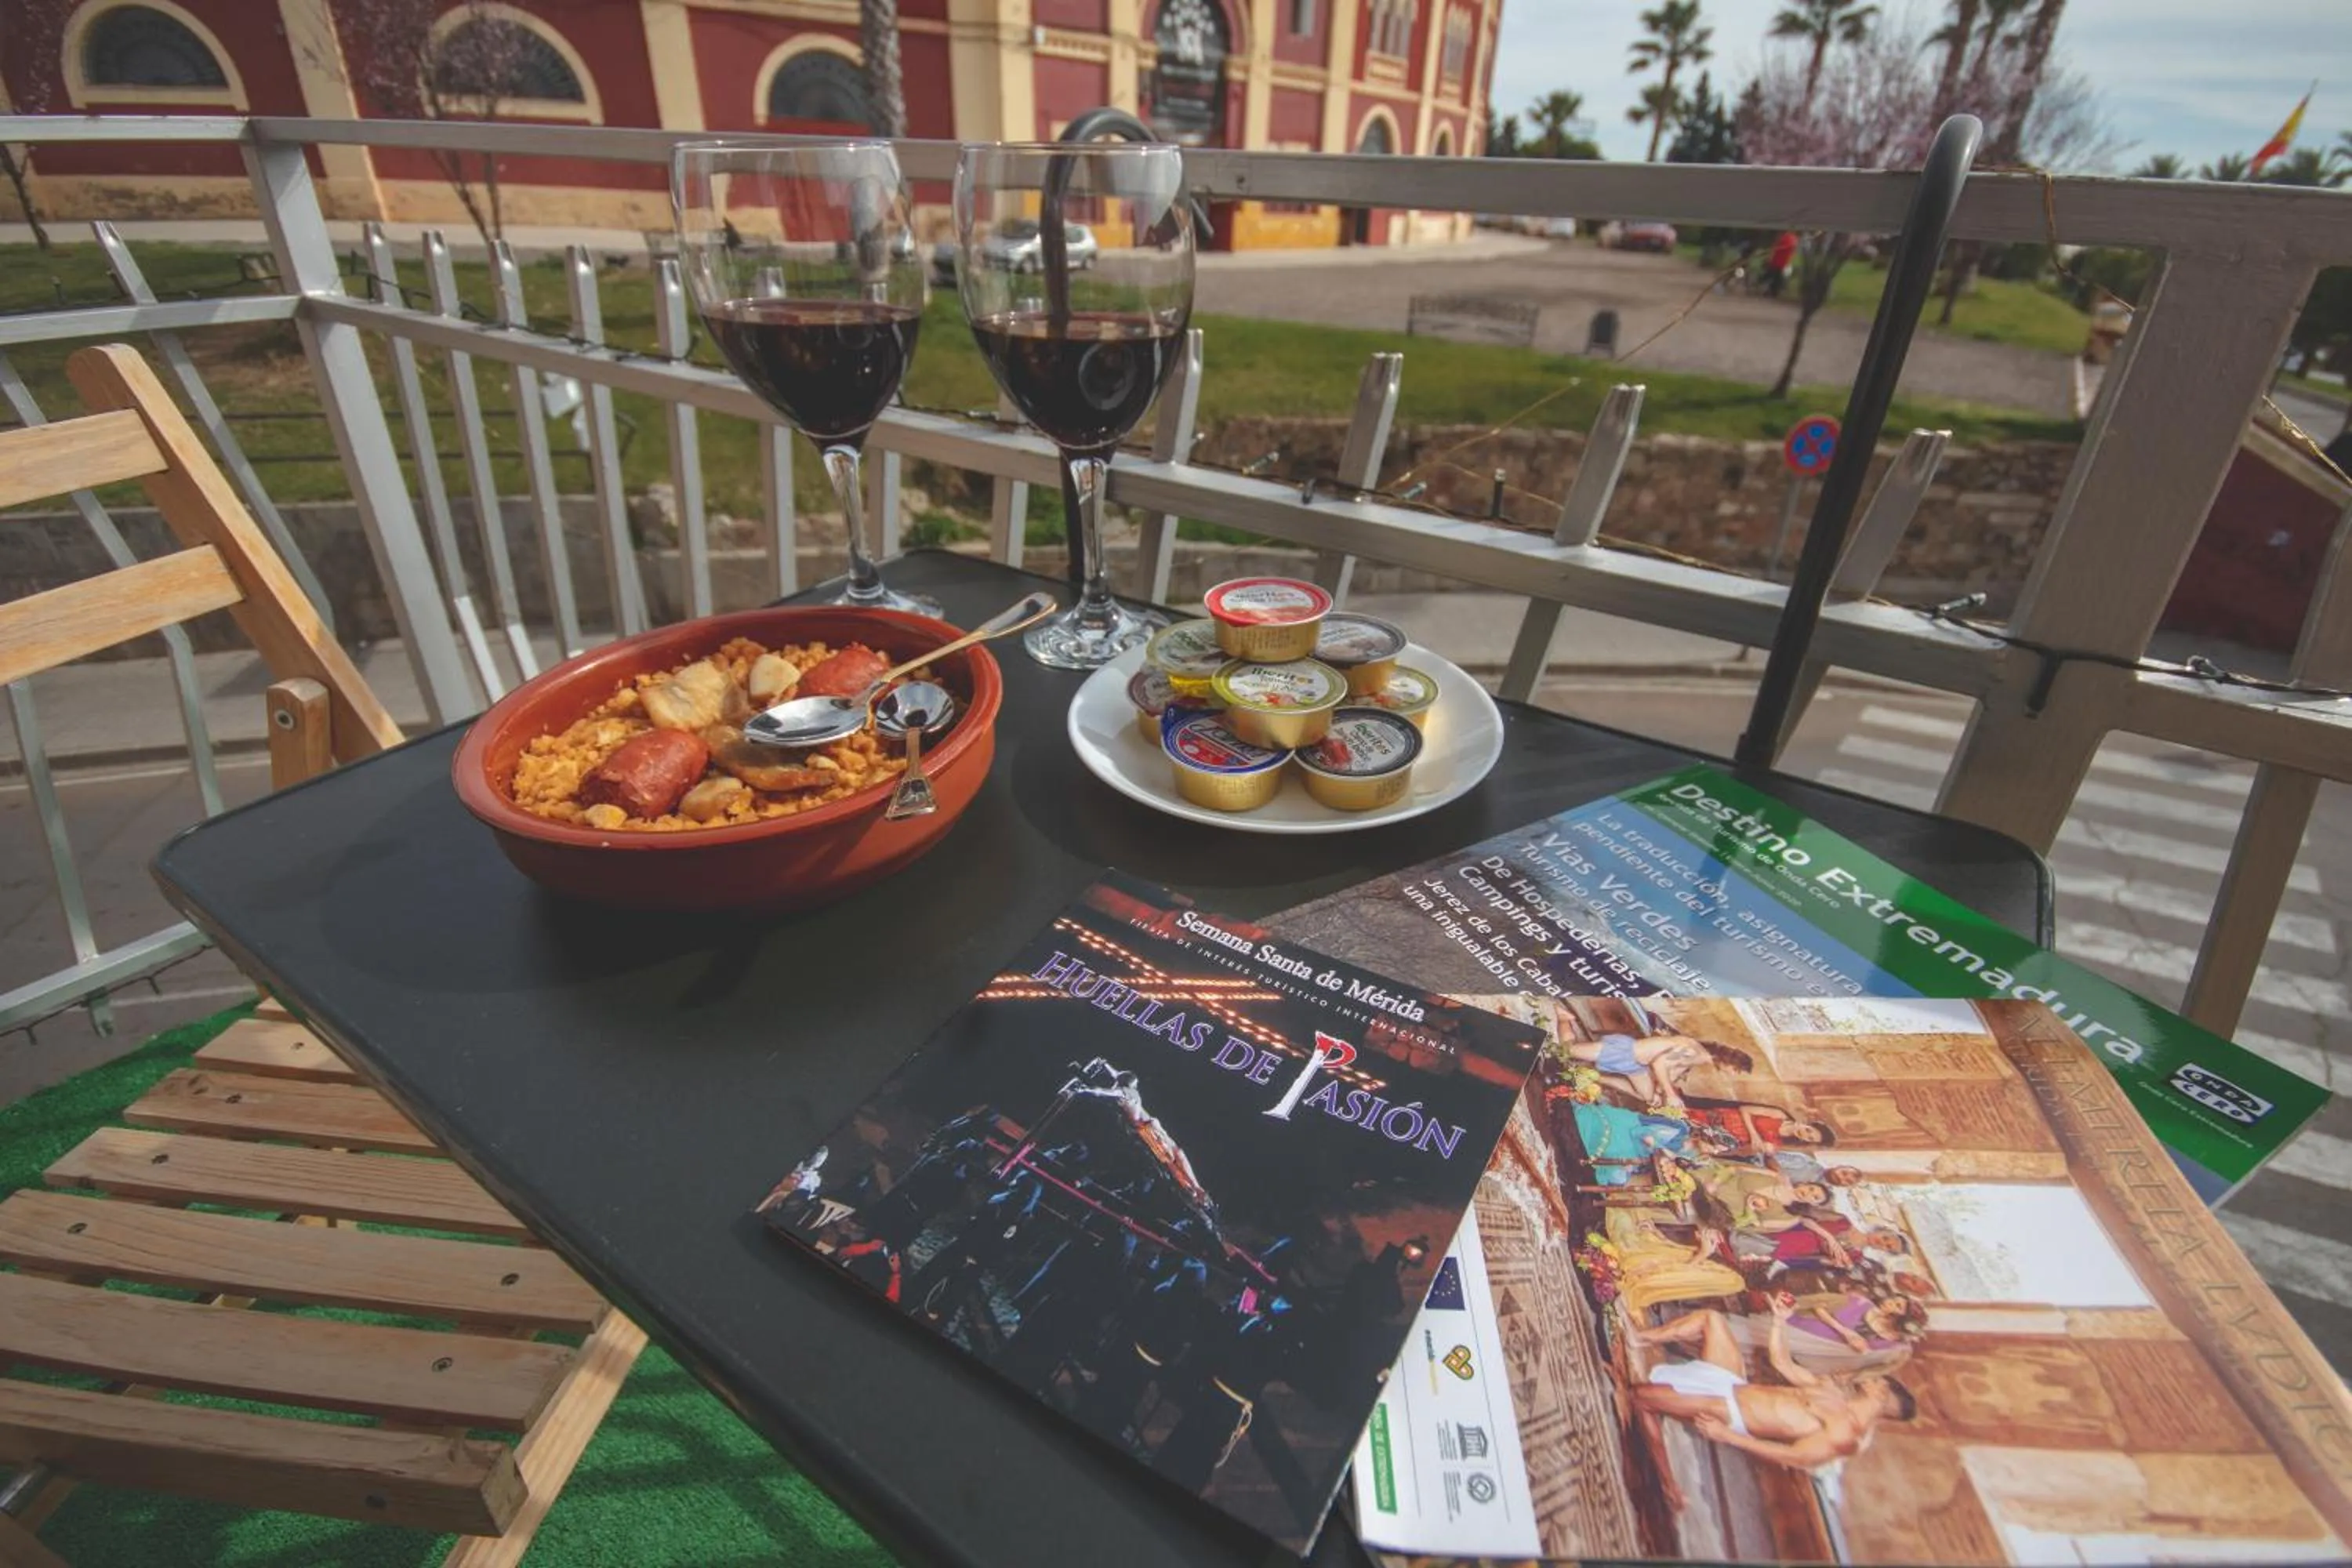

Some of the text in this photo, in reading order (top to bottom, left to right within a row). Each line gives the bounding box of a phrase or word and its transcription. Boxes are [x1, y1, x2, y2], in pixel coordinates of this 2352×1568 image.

[1403, 884, 1519, 989] una inigualable
[1423, 879, 1472, 916] Jerez
[1467, 915, 1493, 935] de
[1490, 934, 1519, 958] los
[1458, 865, 1553, 942] Campings
[1544, 942, 1573, 957] y
[1481, 855, 1640, 989] De Hospederías,
[1521, 842, 1711, 991] Turismo de reciclaje
[1542, 833, 1700, 953] Vías Verdes
[1571, 821, 1674, 889] pendiente
[1675, 889, 1715, 917] del
[1712, 916, 1804, 981] turismo
[1599, 814, 1622, 831] La
[1624, 829, 1730, 909] traducción,
[1738, 909, 1864, 995] asignatura
[1671, 783, 2143, 1064] Destino Extremadura
[1756, 853, 1774, 866] de
[1775, 863, 1807, 888] Onda
[1808, 885, 1841, 909] Cero
[1129, 917, 1170, 939] FIESTA
[1177, 938, 1192, 949] DE
[1334, 1004, 1456, 1055] INTERNACIONAL
[1176, 911, 1425, 1023] Semana Santa de Mérida
[1031, 949, 1468, 1160] HUELLAS DE PASIÓN
[2183, 1083, 2243, 1117] CERO
[2190, 1071, 2253, 1107] ONDA
[2199, 1281, 2352, 1482] LVDIC
